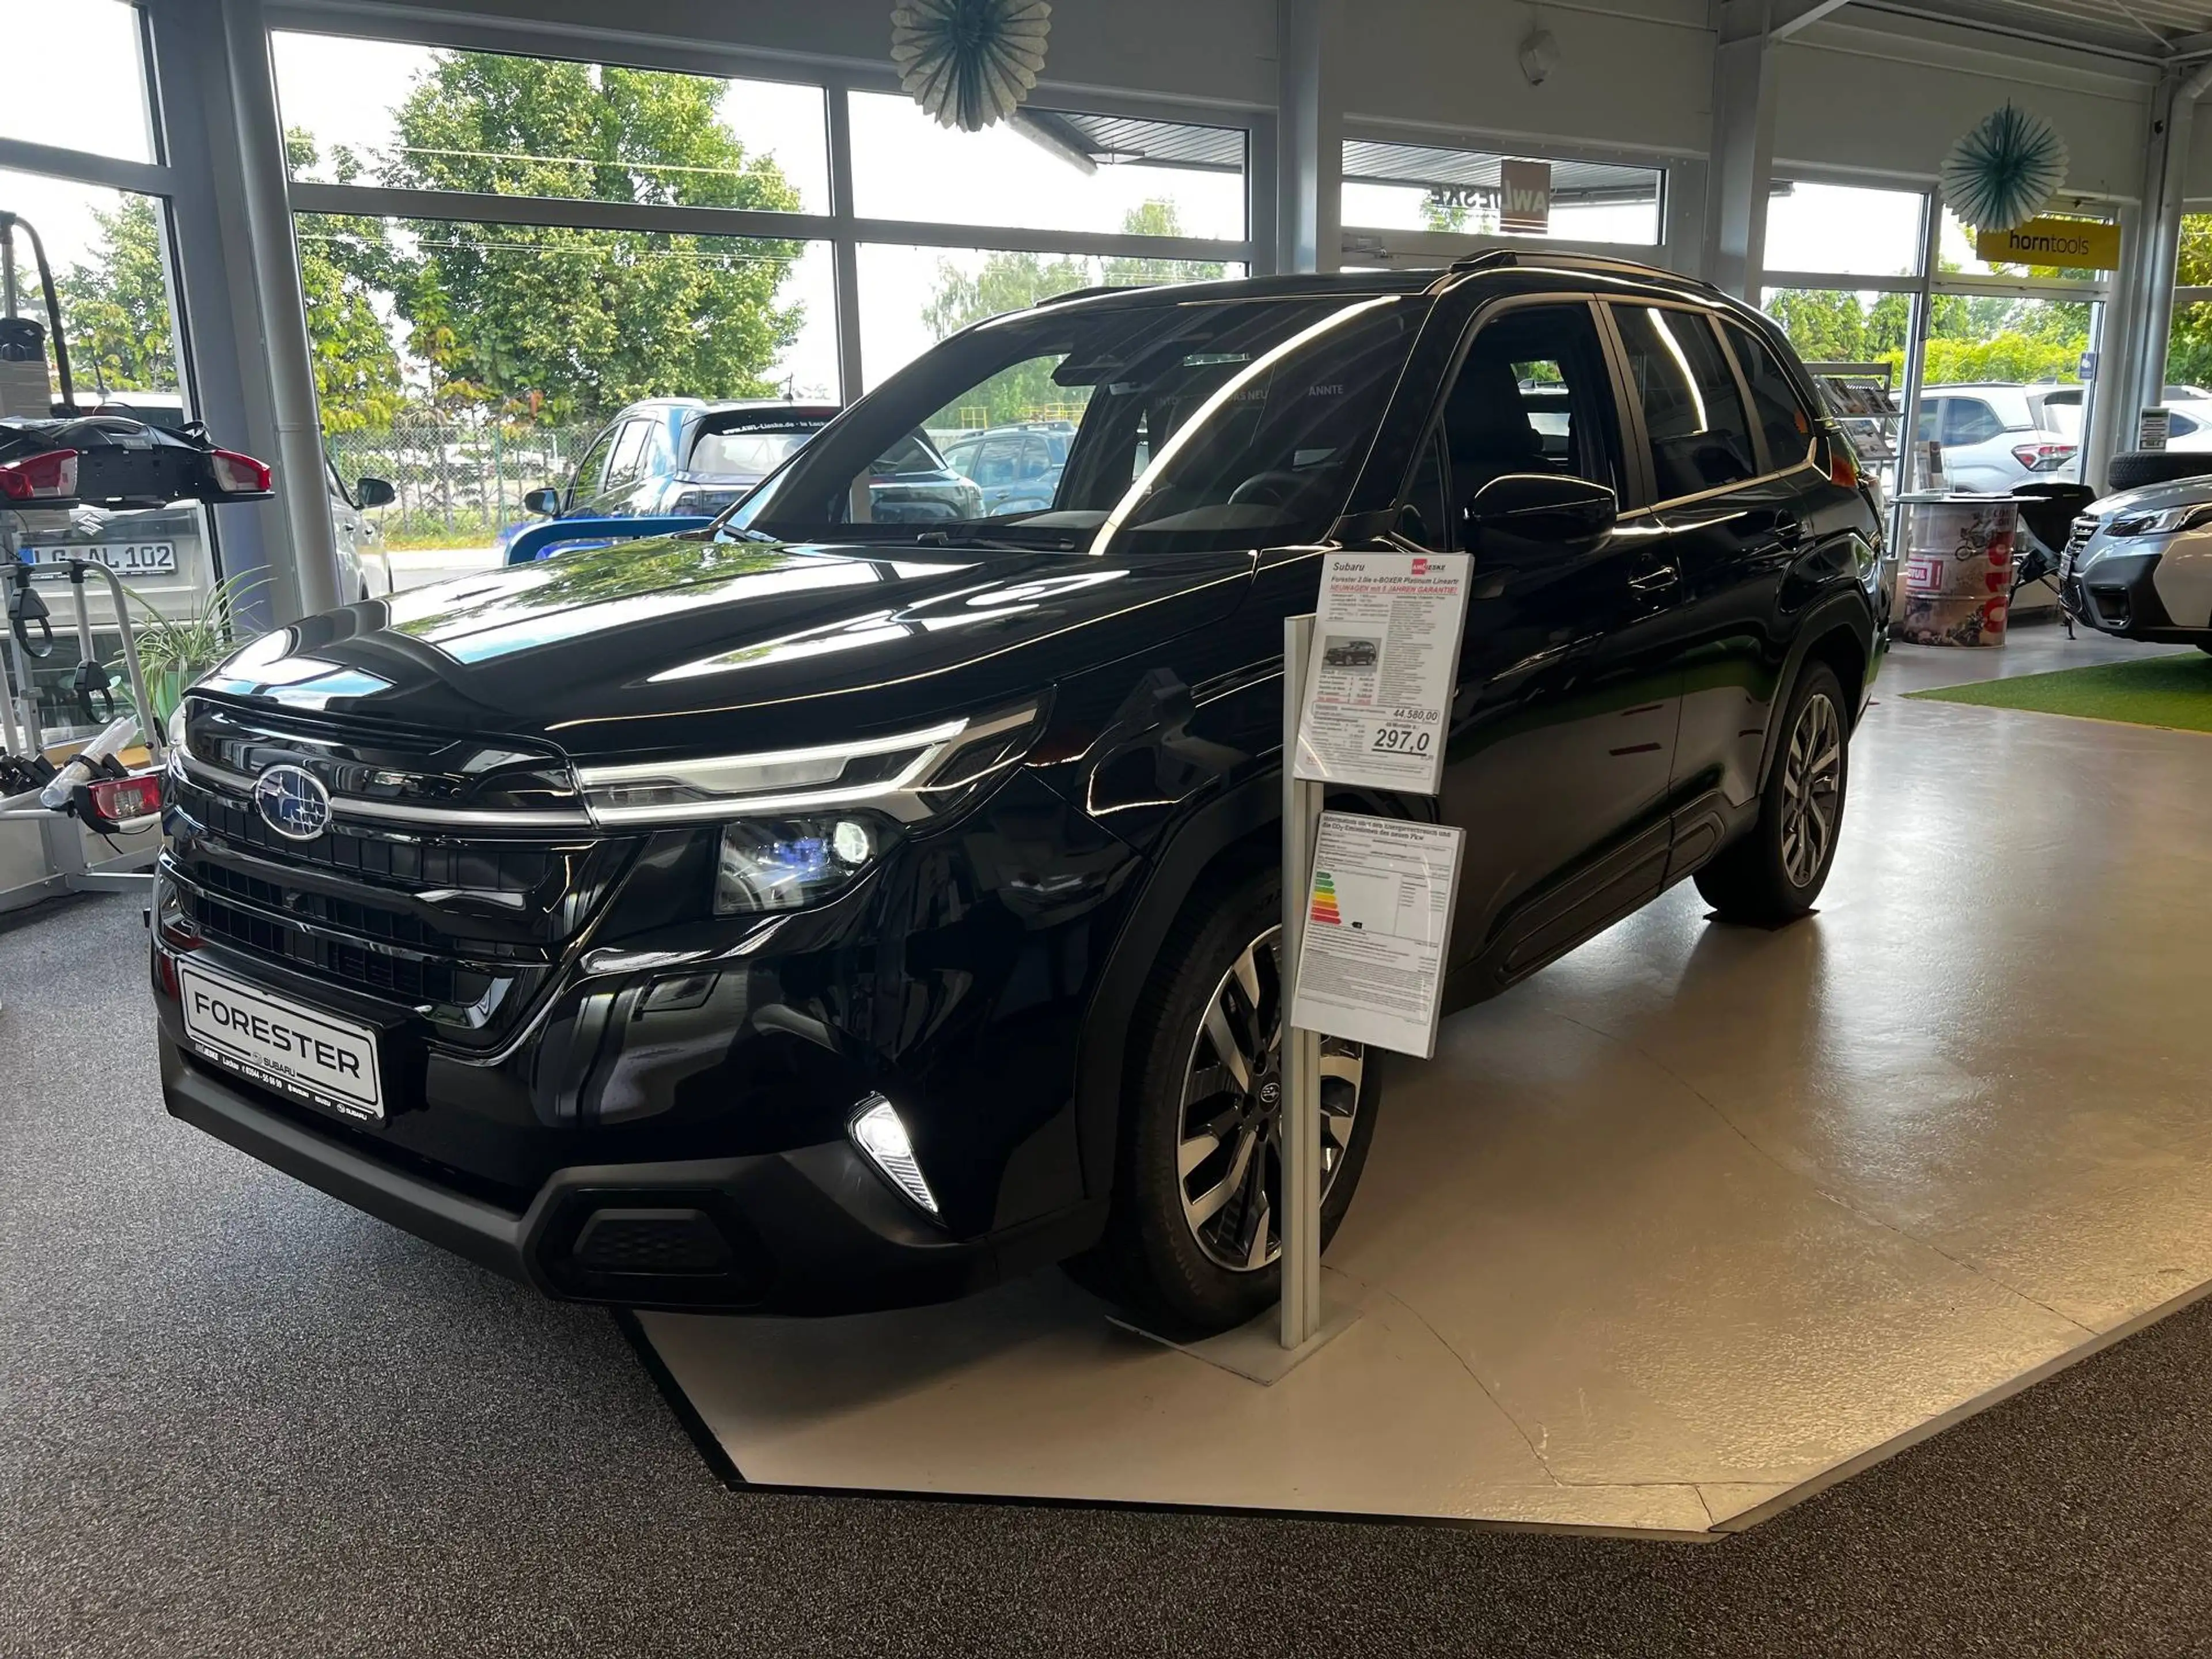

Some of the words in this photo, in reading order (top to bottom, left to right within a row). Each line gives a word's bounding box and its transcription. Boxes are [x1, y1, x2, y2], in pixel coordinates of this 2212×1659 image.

[2009, 230, 2089, 255] horntools
[125, 546, 172, 568] 102
[1333, 562, 1365, 571] Subaru
[1373, 728, 1430, 753] 297,0
[194, 991, 361, 1079] FORESTER
[263, 1058, 296, 1077] SUBARU
